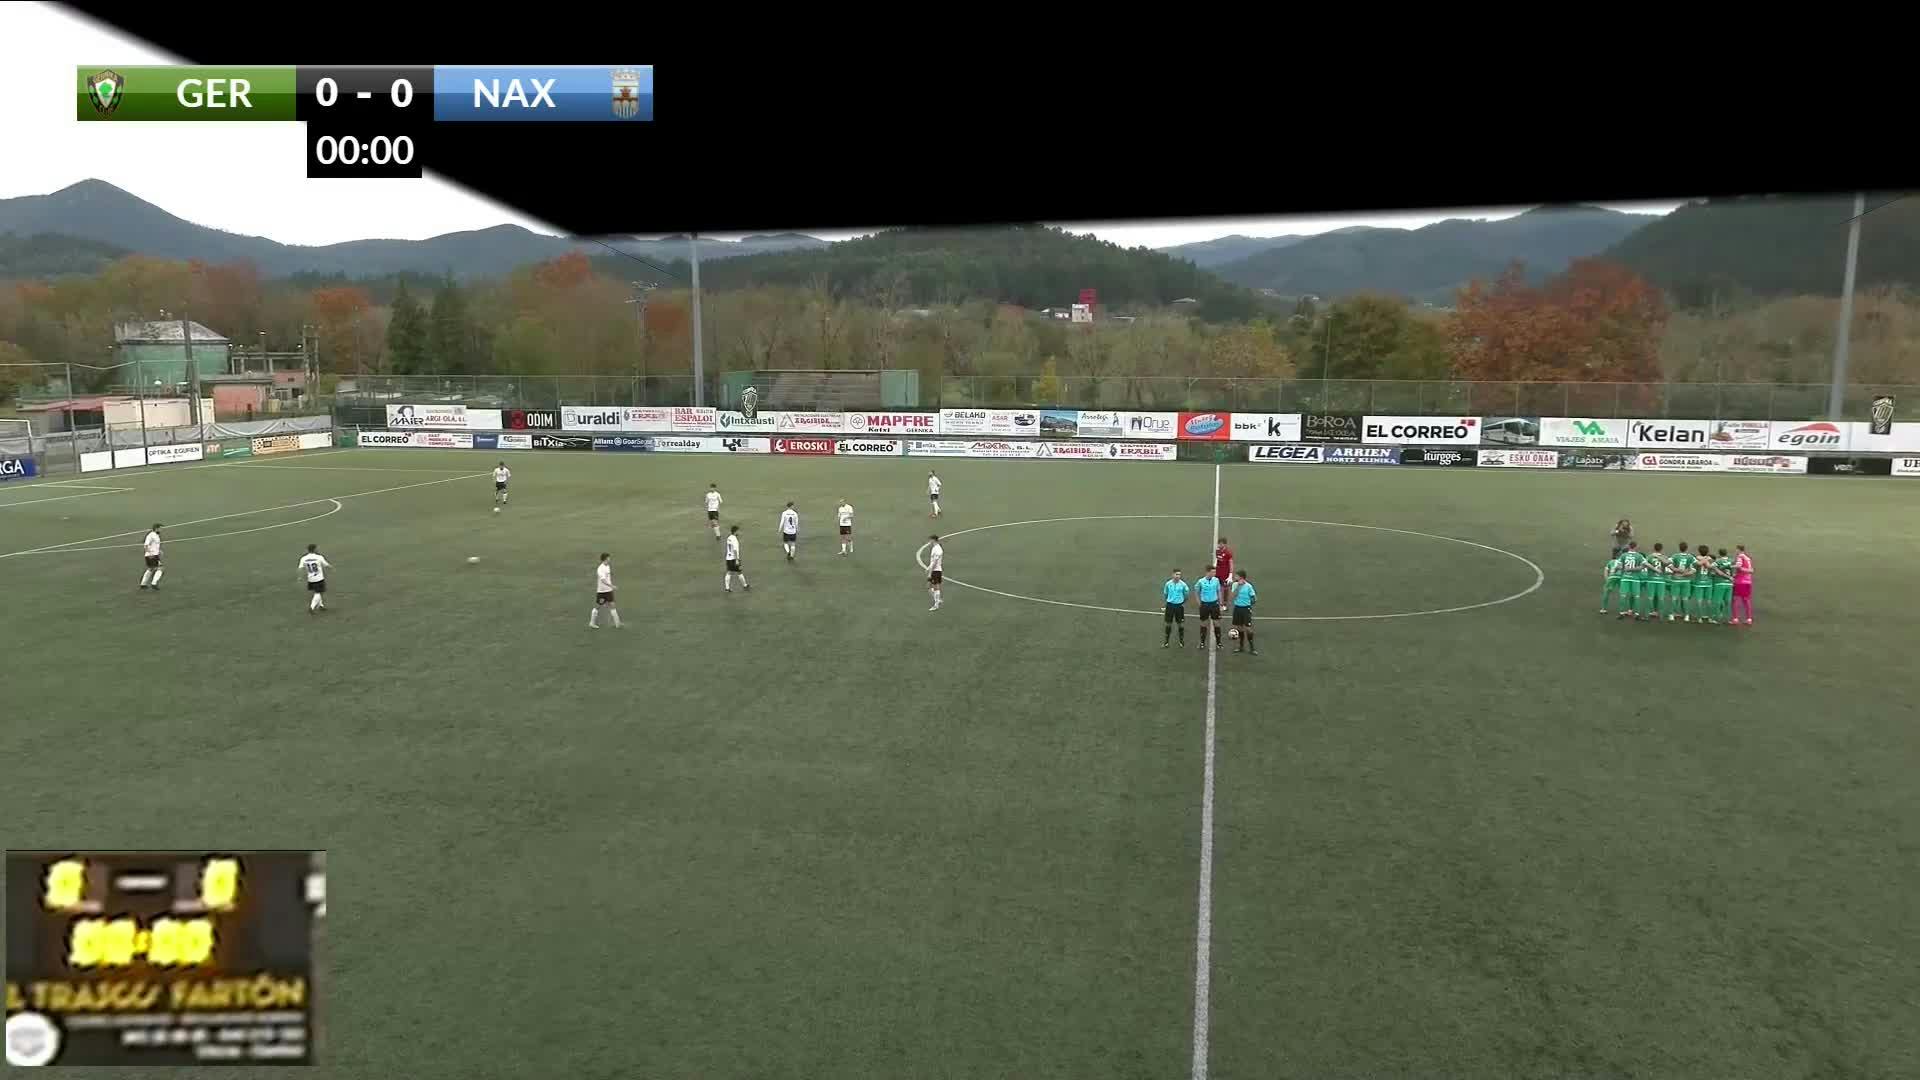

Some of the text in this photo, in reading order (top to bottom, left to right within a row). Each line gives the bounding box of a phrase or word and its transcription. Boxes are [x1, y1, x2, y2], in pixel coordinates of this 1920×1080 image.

[731, 416, 775, 425] Intxausti
[867, 415, 934, 427] MAPFRE
[1366, 424, 1389, 438] EL
[1391, 424, 1468, 439] CORREO
[1639, 424, 1705, 443] Kelan
[373, 436, 409, 444] CORREO
[1778, 432, 1840, 446] egoin
[790, 441, 828, 451] EROSKI
[840, 443, 894, 452] EL CORREO
[1255, 446, 1319, 459] LEGEA
[1332, 448, 1392, 457] ARRIEN
[1533, 454, 1554, 464] ONAK
